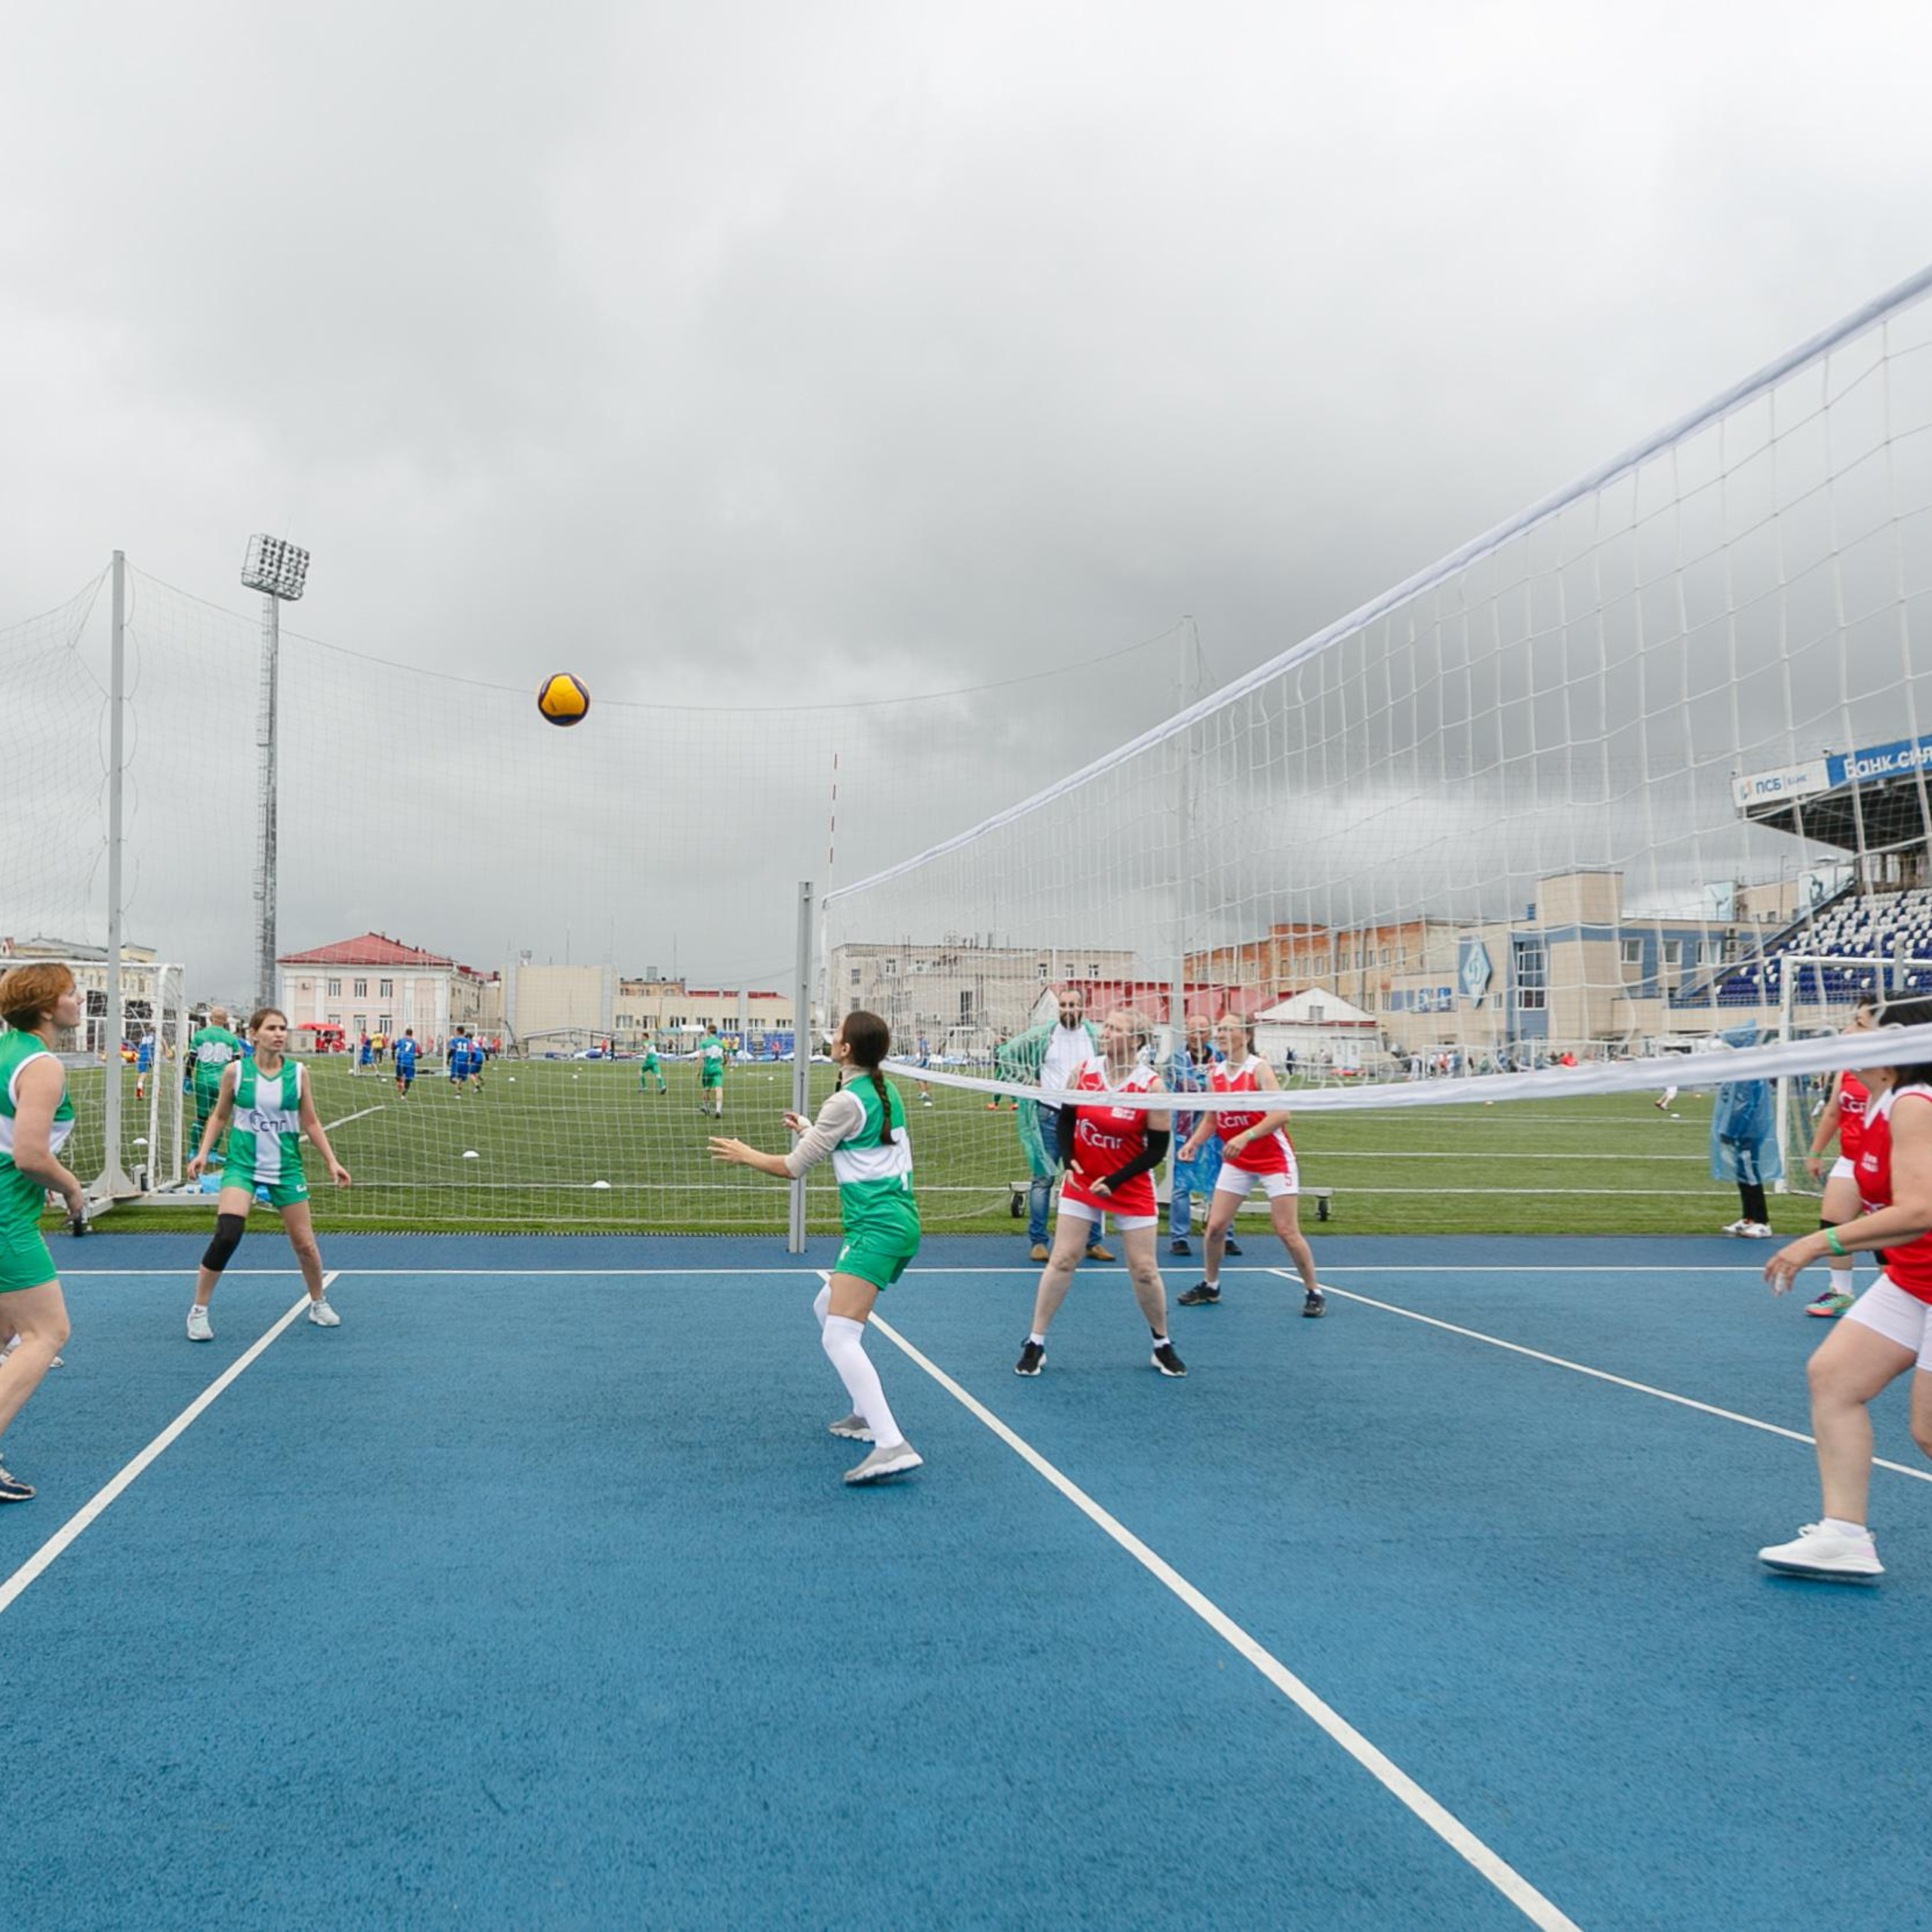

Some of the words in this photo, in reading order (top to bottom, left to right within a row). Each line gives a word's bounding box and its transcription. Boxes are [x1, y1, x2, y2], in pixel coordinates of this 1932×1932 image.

[1844, 755, 1892, 780] Банк
[1756, 778, 1781, 794] ПСБ
[405, 1041, 412, 1052] 7
[457, 1041, 467, 1052] 11
